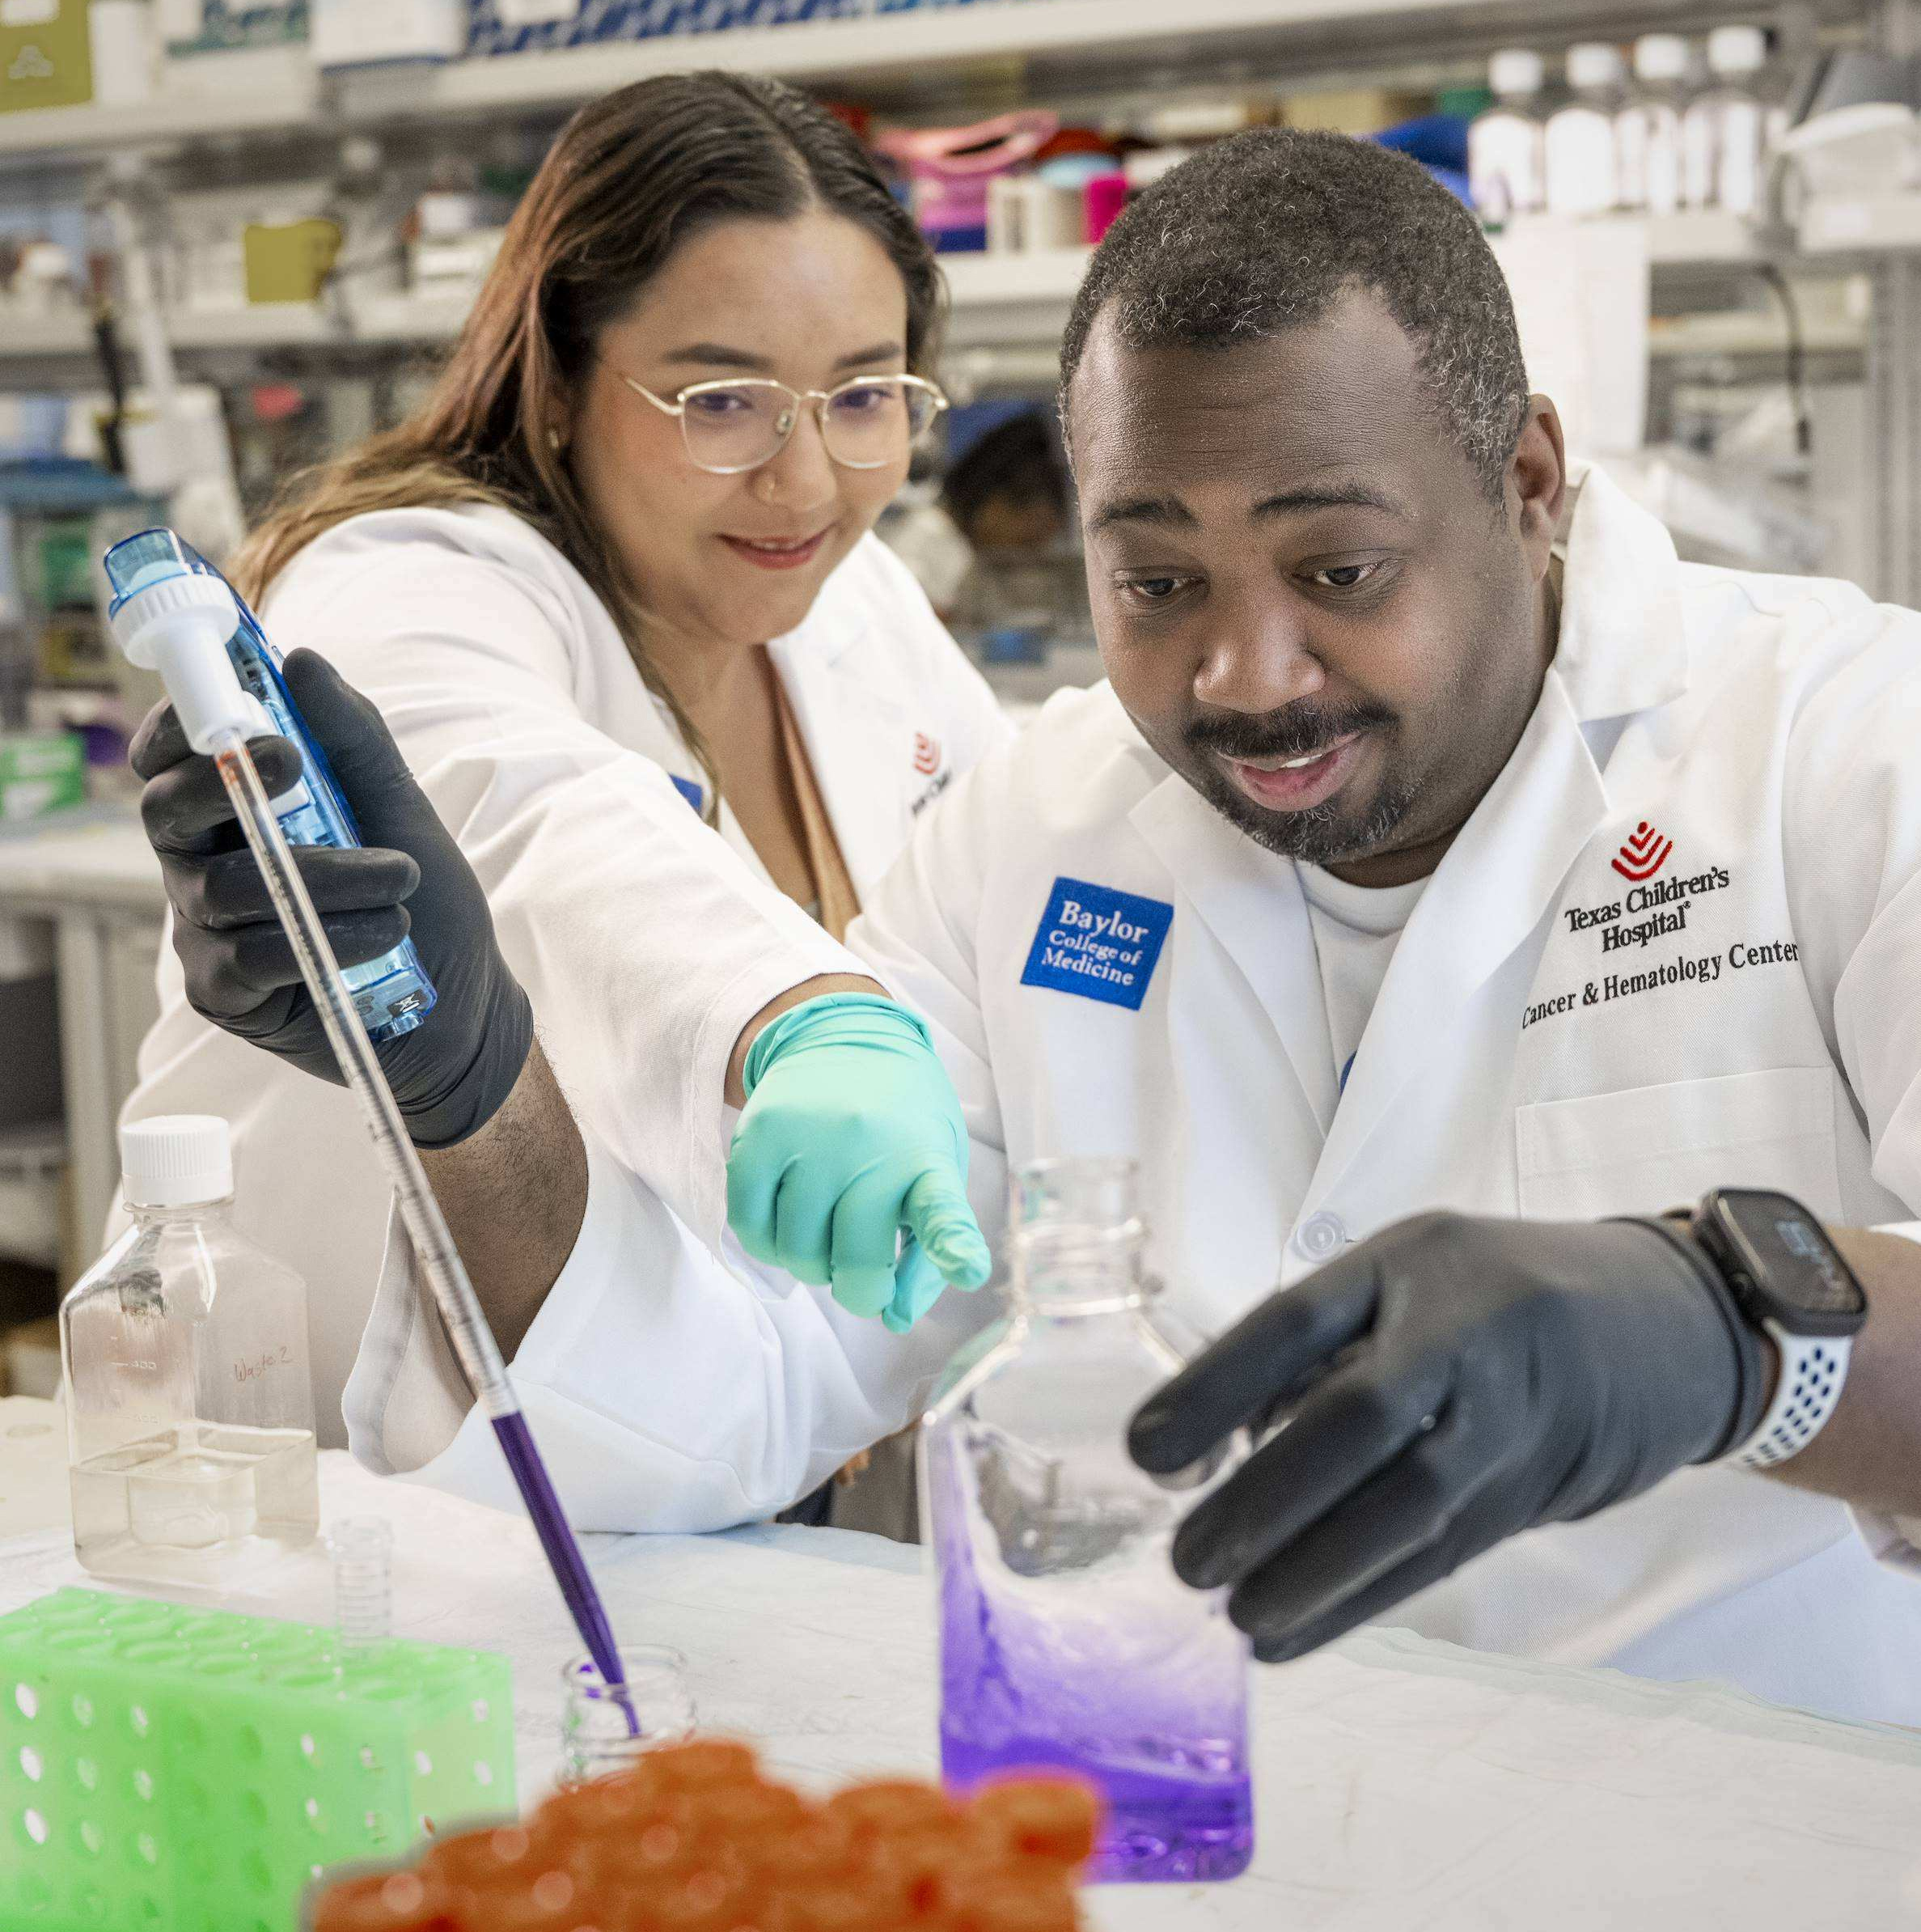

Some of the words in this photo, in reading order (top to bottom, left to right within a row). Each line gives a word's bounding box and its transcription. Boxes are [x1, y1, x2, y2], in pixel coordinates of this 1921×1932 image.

[1564, 902, 1622, 932] Texas
[1627, 866, 1730, 913] Children's
[1060, 900, 1149, 943] Baylor
[1042, 947, 1135, 985] Medicine
[1049, 930, 1119, 961] College
[1119, 950, 1143, 965] of
[1522, 993, 1576, 1029] Cancer
[1582, 982, 1599, 1006] &
[1604, 952, 1722, 1002] Hematology
[1728, 940, 1798, 968] Center
